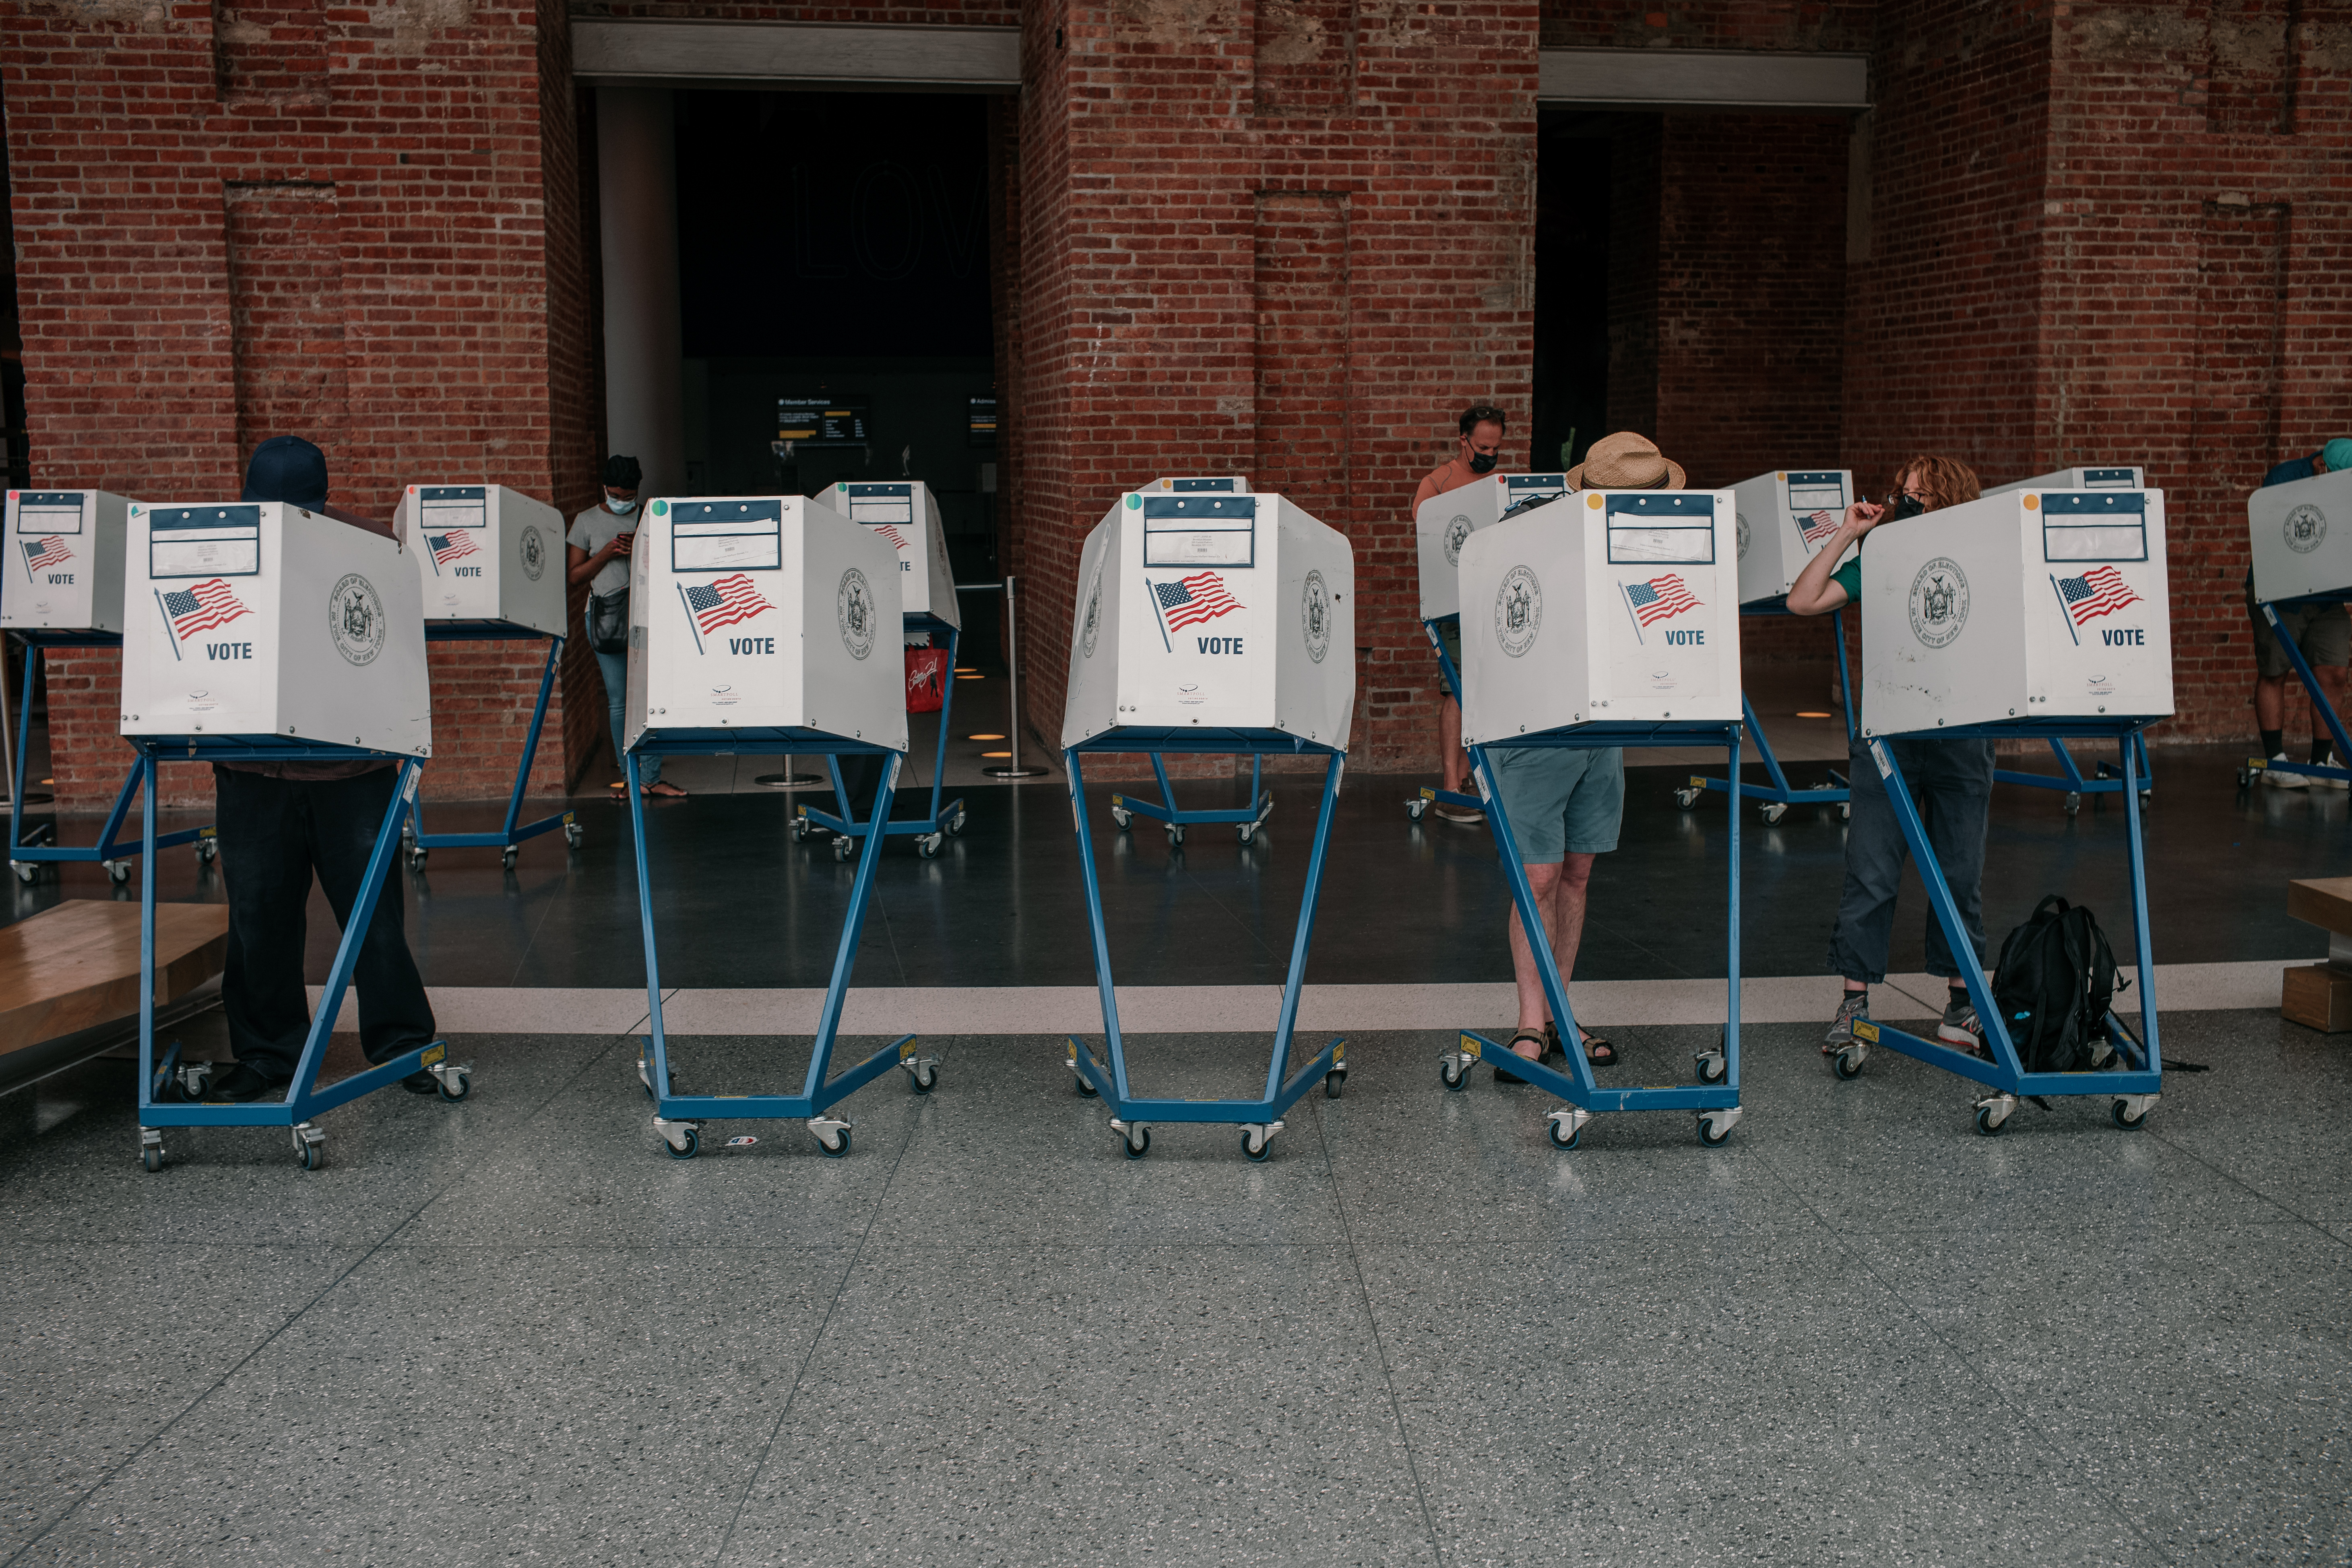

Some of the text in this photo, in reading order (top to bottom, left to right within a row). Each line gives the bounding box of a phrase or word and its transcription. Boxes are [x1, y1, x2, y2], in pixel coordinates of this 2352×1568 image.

[455, 567, 481, 577] VOTE
[900, 562, 911, 571] TE
[48, 574, 74, 584] VOTE
[1510, 571, 1516, 580] OF
[1913, 561, 1965, 597] BOARD OF ELECTIONS
[1911, 607, 1916, 617] IN
[1958, 599, 1967, 623] YORK
[1913, 618, 1922, 633] THE
[1945, 624, 1958, 640] NEW
[1665, 630, 1704, 645] VOTE
[1922, 633, 1935, 644] CITY
[2102, 629, 2145, 646] VOTE
[207, 642, 252, 660] VOTE
[729, 638, 774, 655] VOTE
[1197, 637, 1243, 655] VOTE
[1505, 642, 1516, 653] CITY
[1516, 645, 1523, 653] OF
